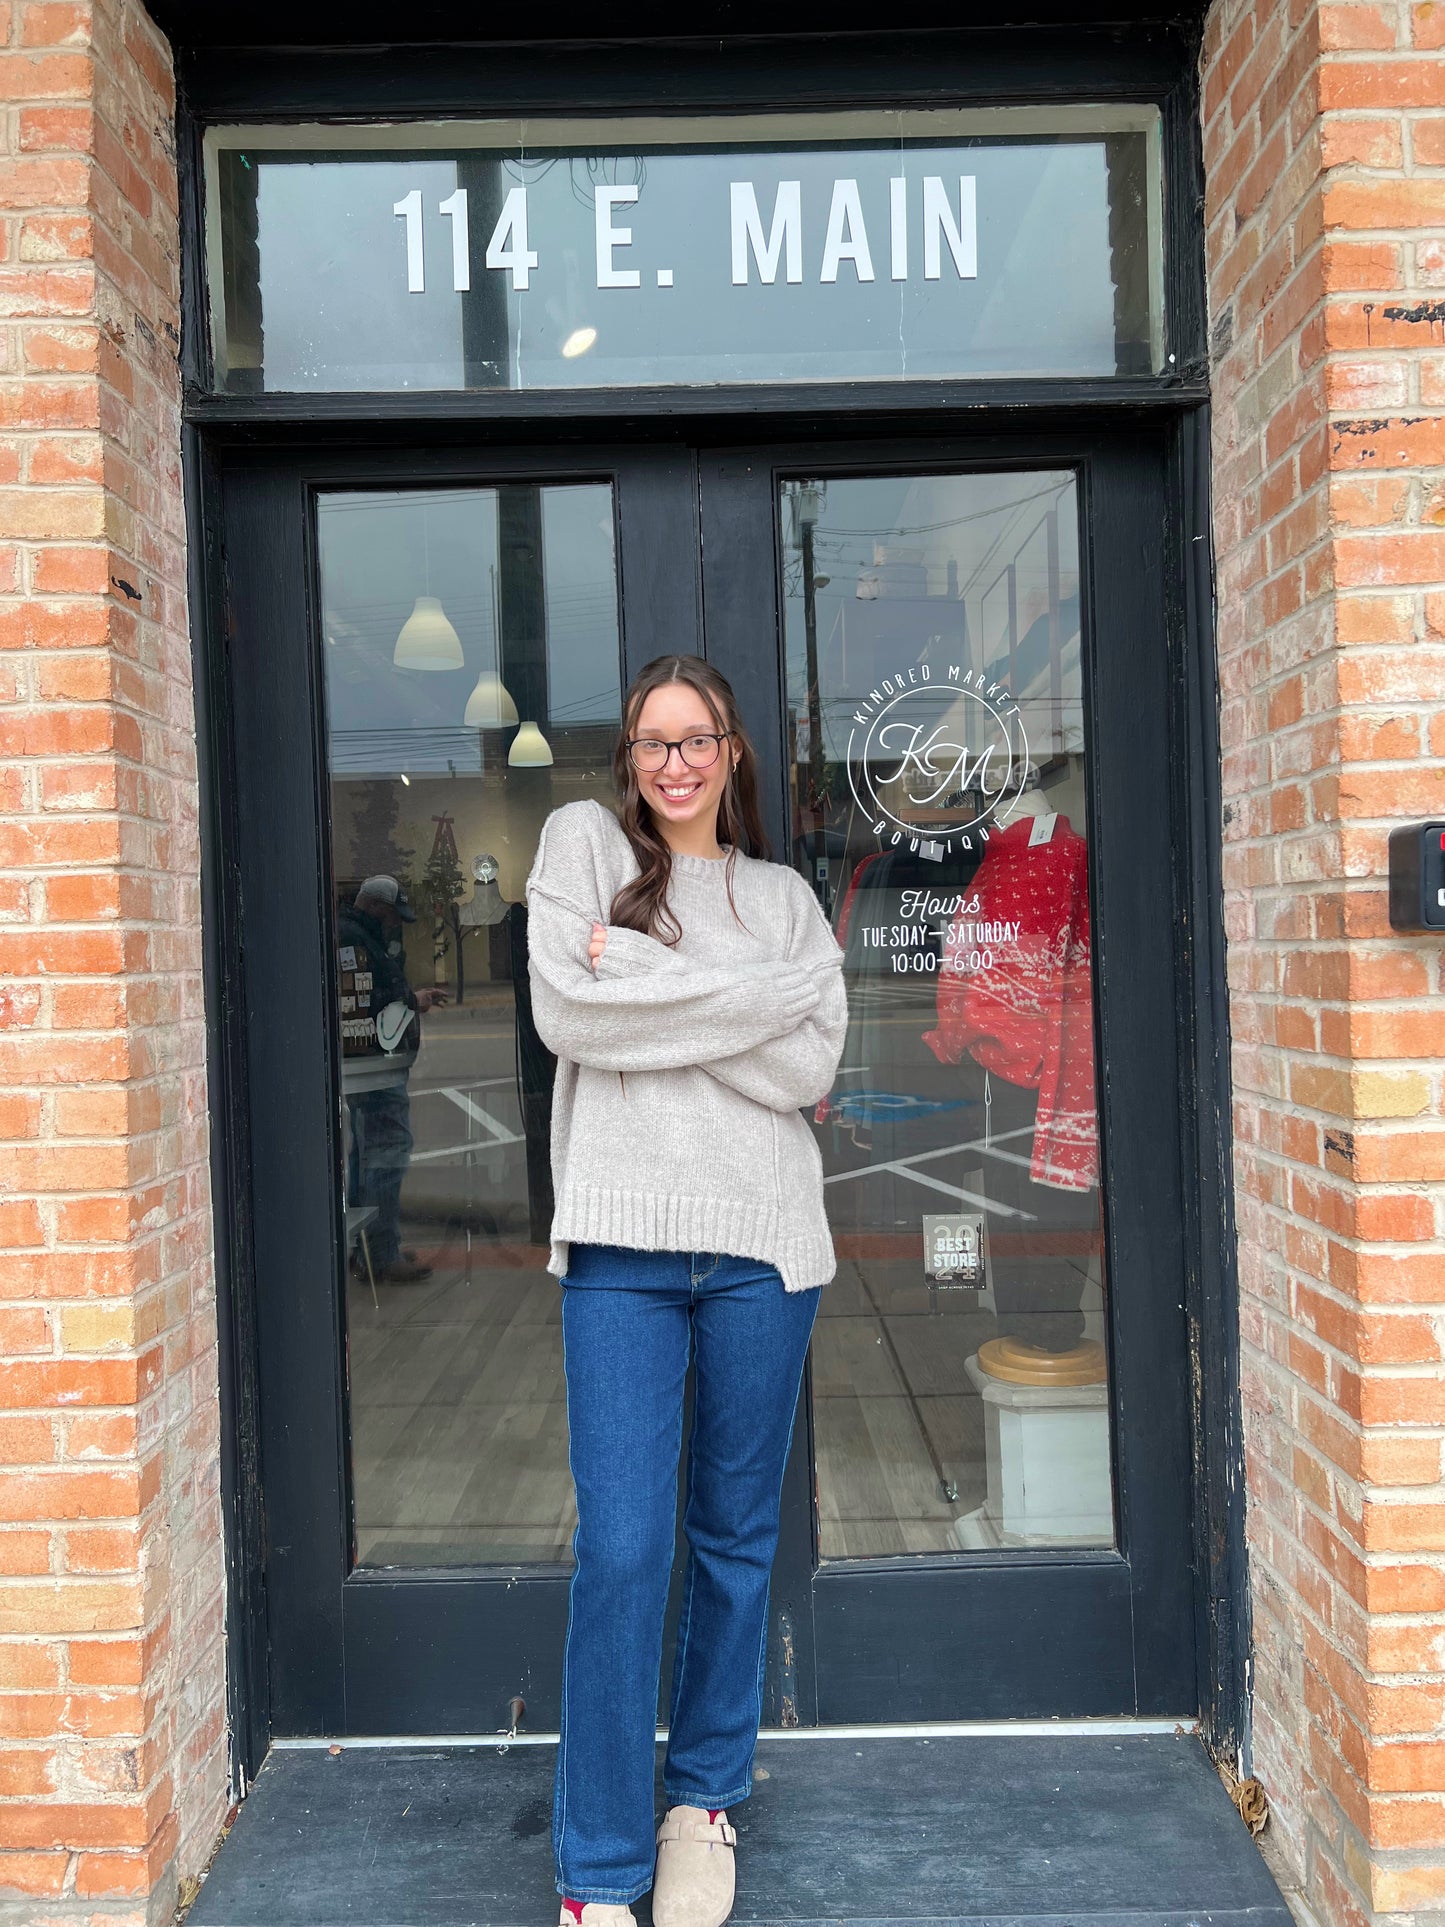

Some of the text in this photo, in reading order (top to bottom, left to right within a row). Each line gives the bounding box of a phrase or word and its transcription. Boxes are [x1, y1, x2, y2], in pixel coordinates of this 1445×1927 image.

[393, 175, 977, 293] 114 E. MAIN
[853, 664, 1021, 724] KINDRED MARKET
[873, 816, 1006, 854] BOUTIQUE
[900, 890, 980, 922] Hours
[933, 1253, 977, 1268] STORE
[936, 1237, 971, 1252] BEST
